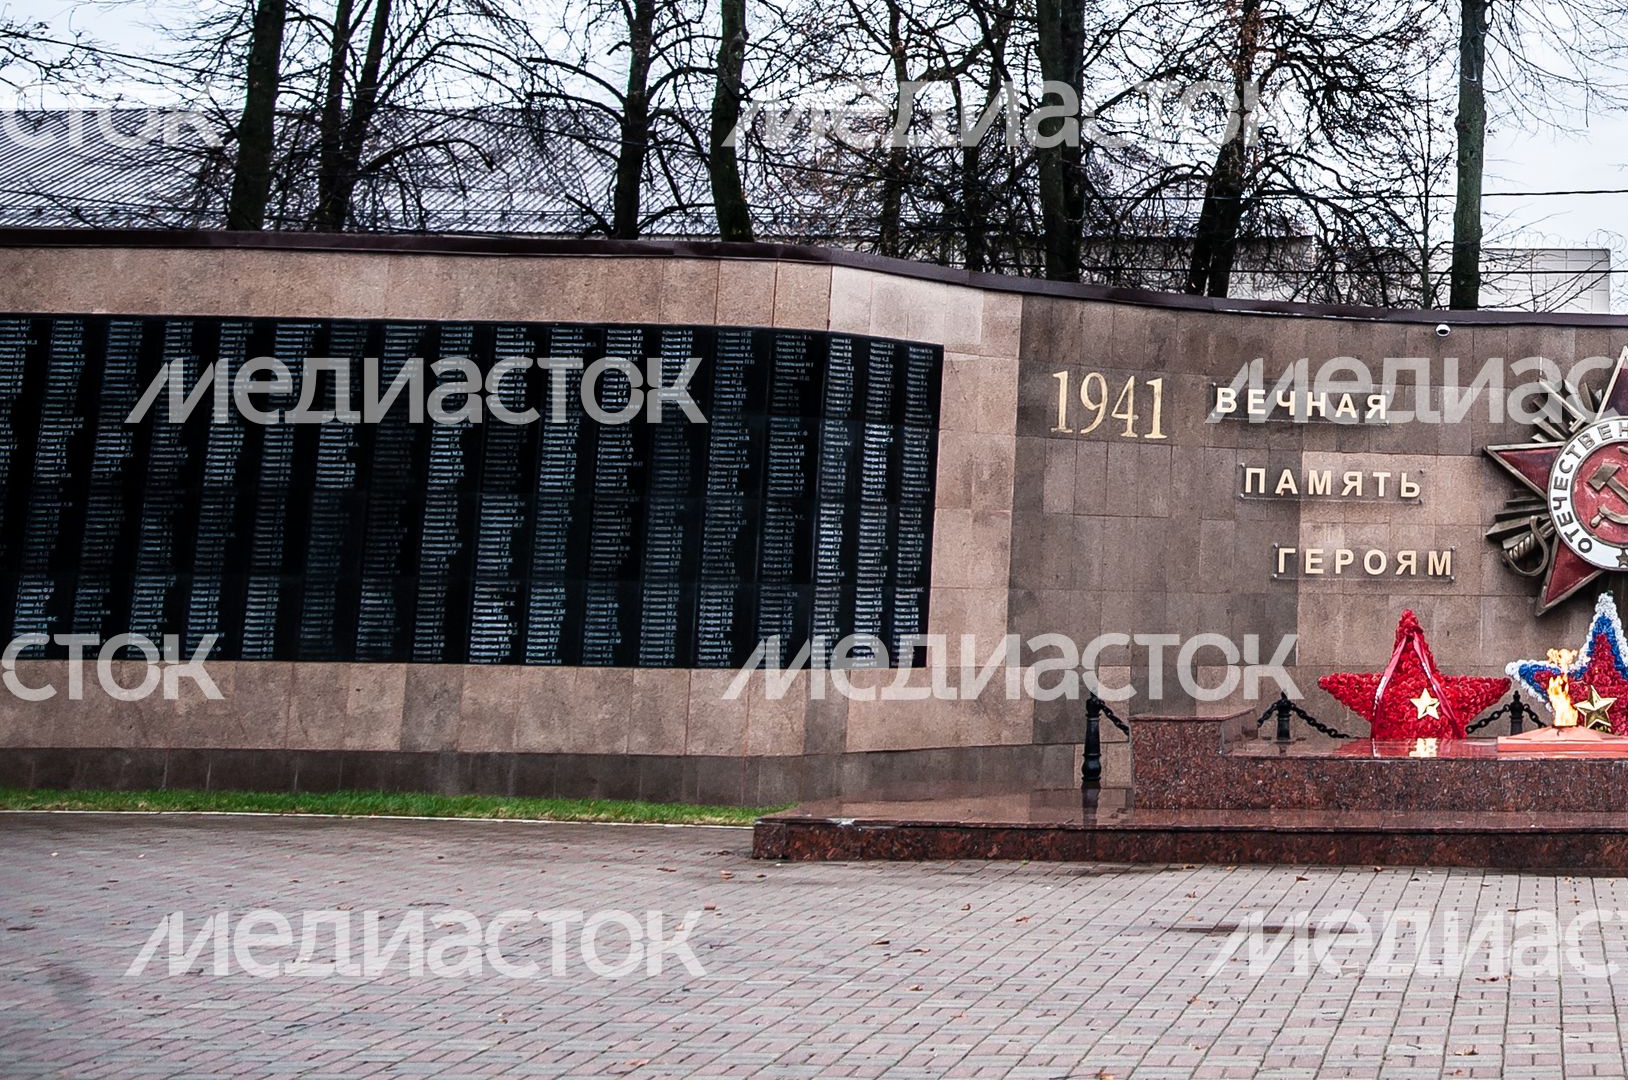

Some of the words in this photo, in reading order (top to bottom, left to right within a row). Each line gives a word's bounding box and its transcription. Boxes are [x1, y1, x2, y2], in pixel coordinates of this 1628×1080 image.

[1051, 370, 1168, 440] 1941
[1215, 386, 1388, 420] ВЕЧНАЯ
[1244, 466, 1422, 499] ПАМЯТЬ
[1276, 547, 1454, 577] ГЕРОЯМ
